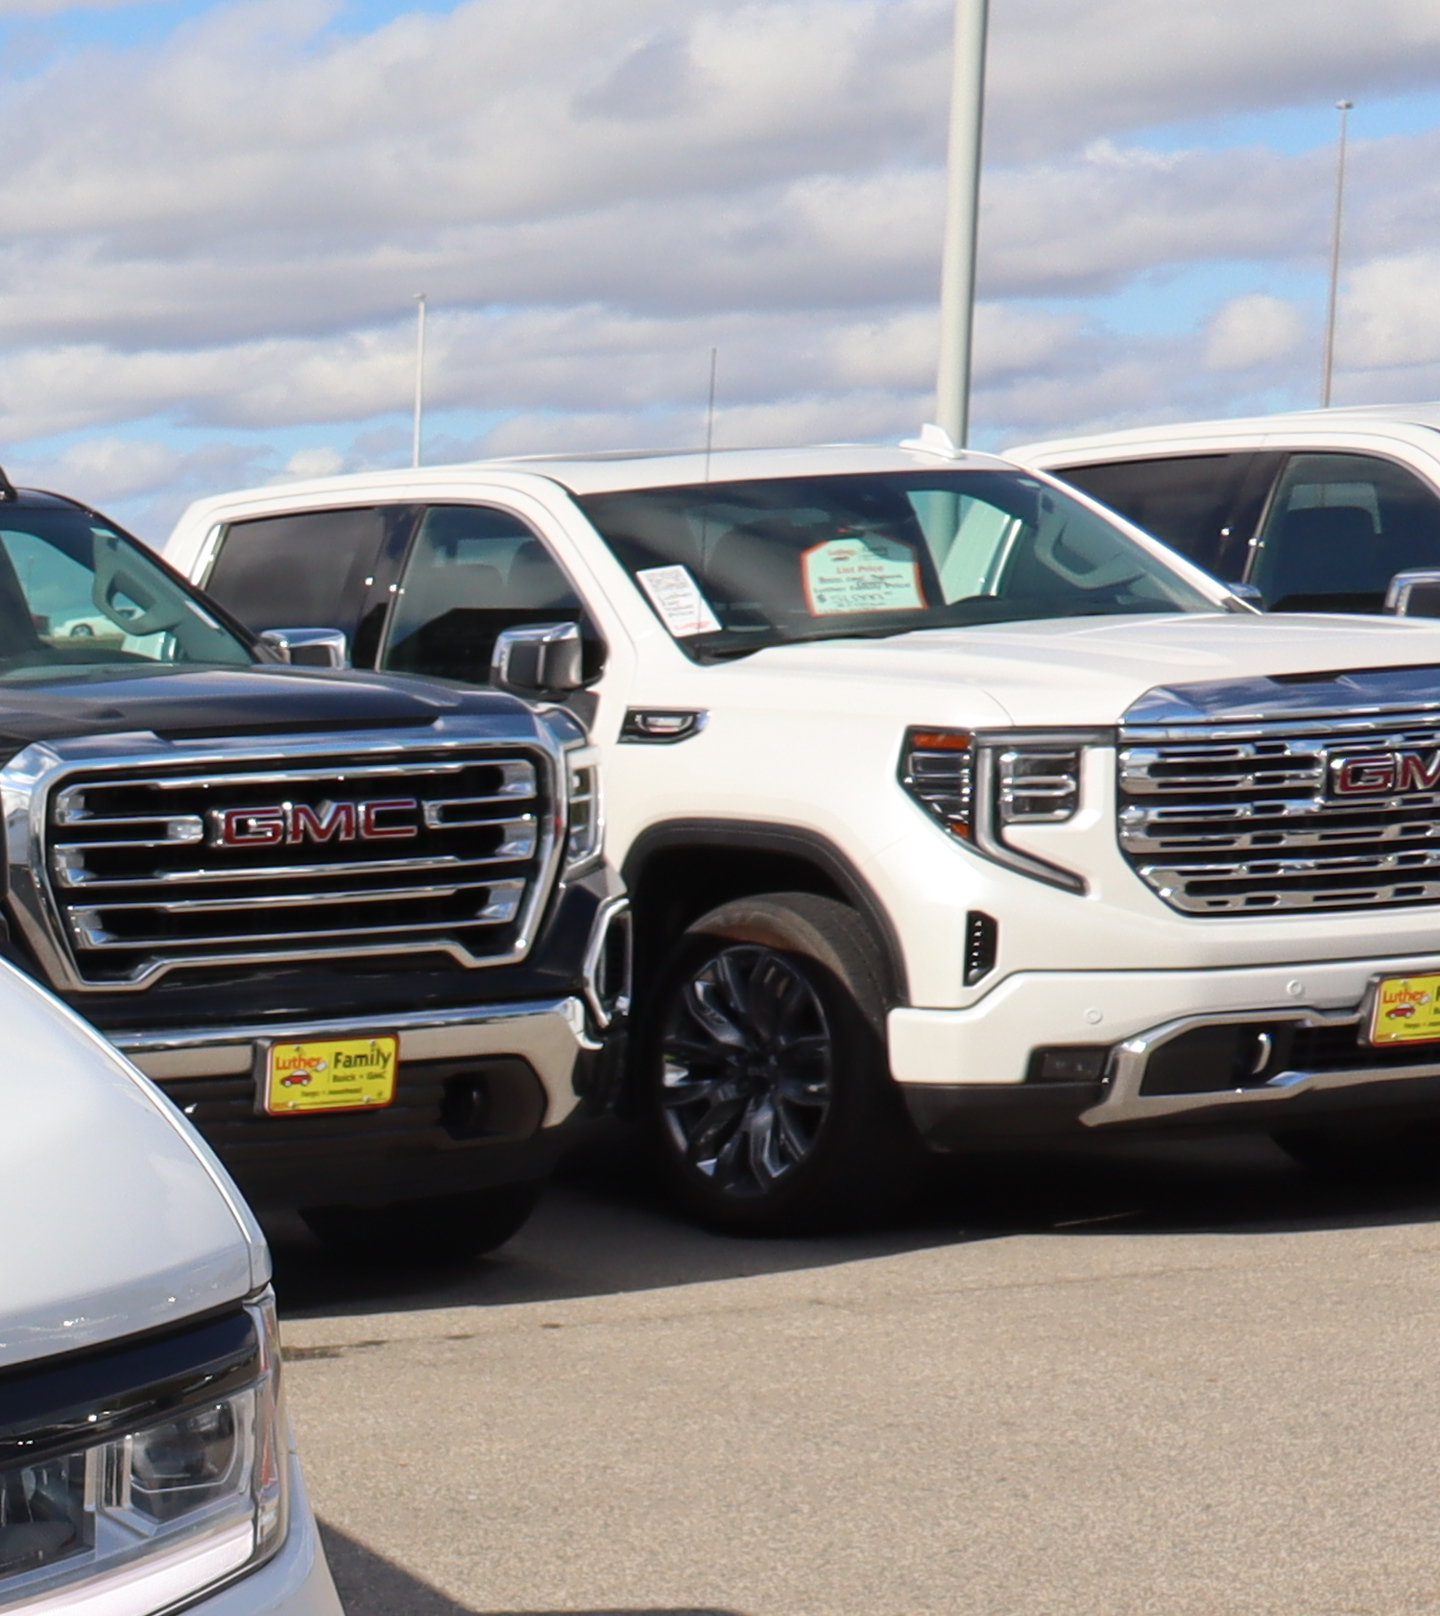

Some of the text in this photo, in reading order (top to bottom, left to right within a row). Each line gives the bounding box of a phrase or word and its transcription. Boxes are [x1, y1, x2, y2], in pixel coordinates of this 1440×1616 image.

[218, 798, 418, 847] GMC
[1383, 989, 1426, 1004] Luther
[274, 1054, 323, 1071] Luther
[333, 1047, 392, 1070] Family
